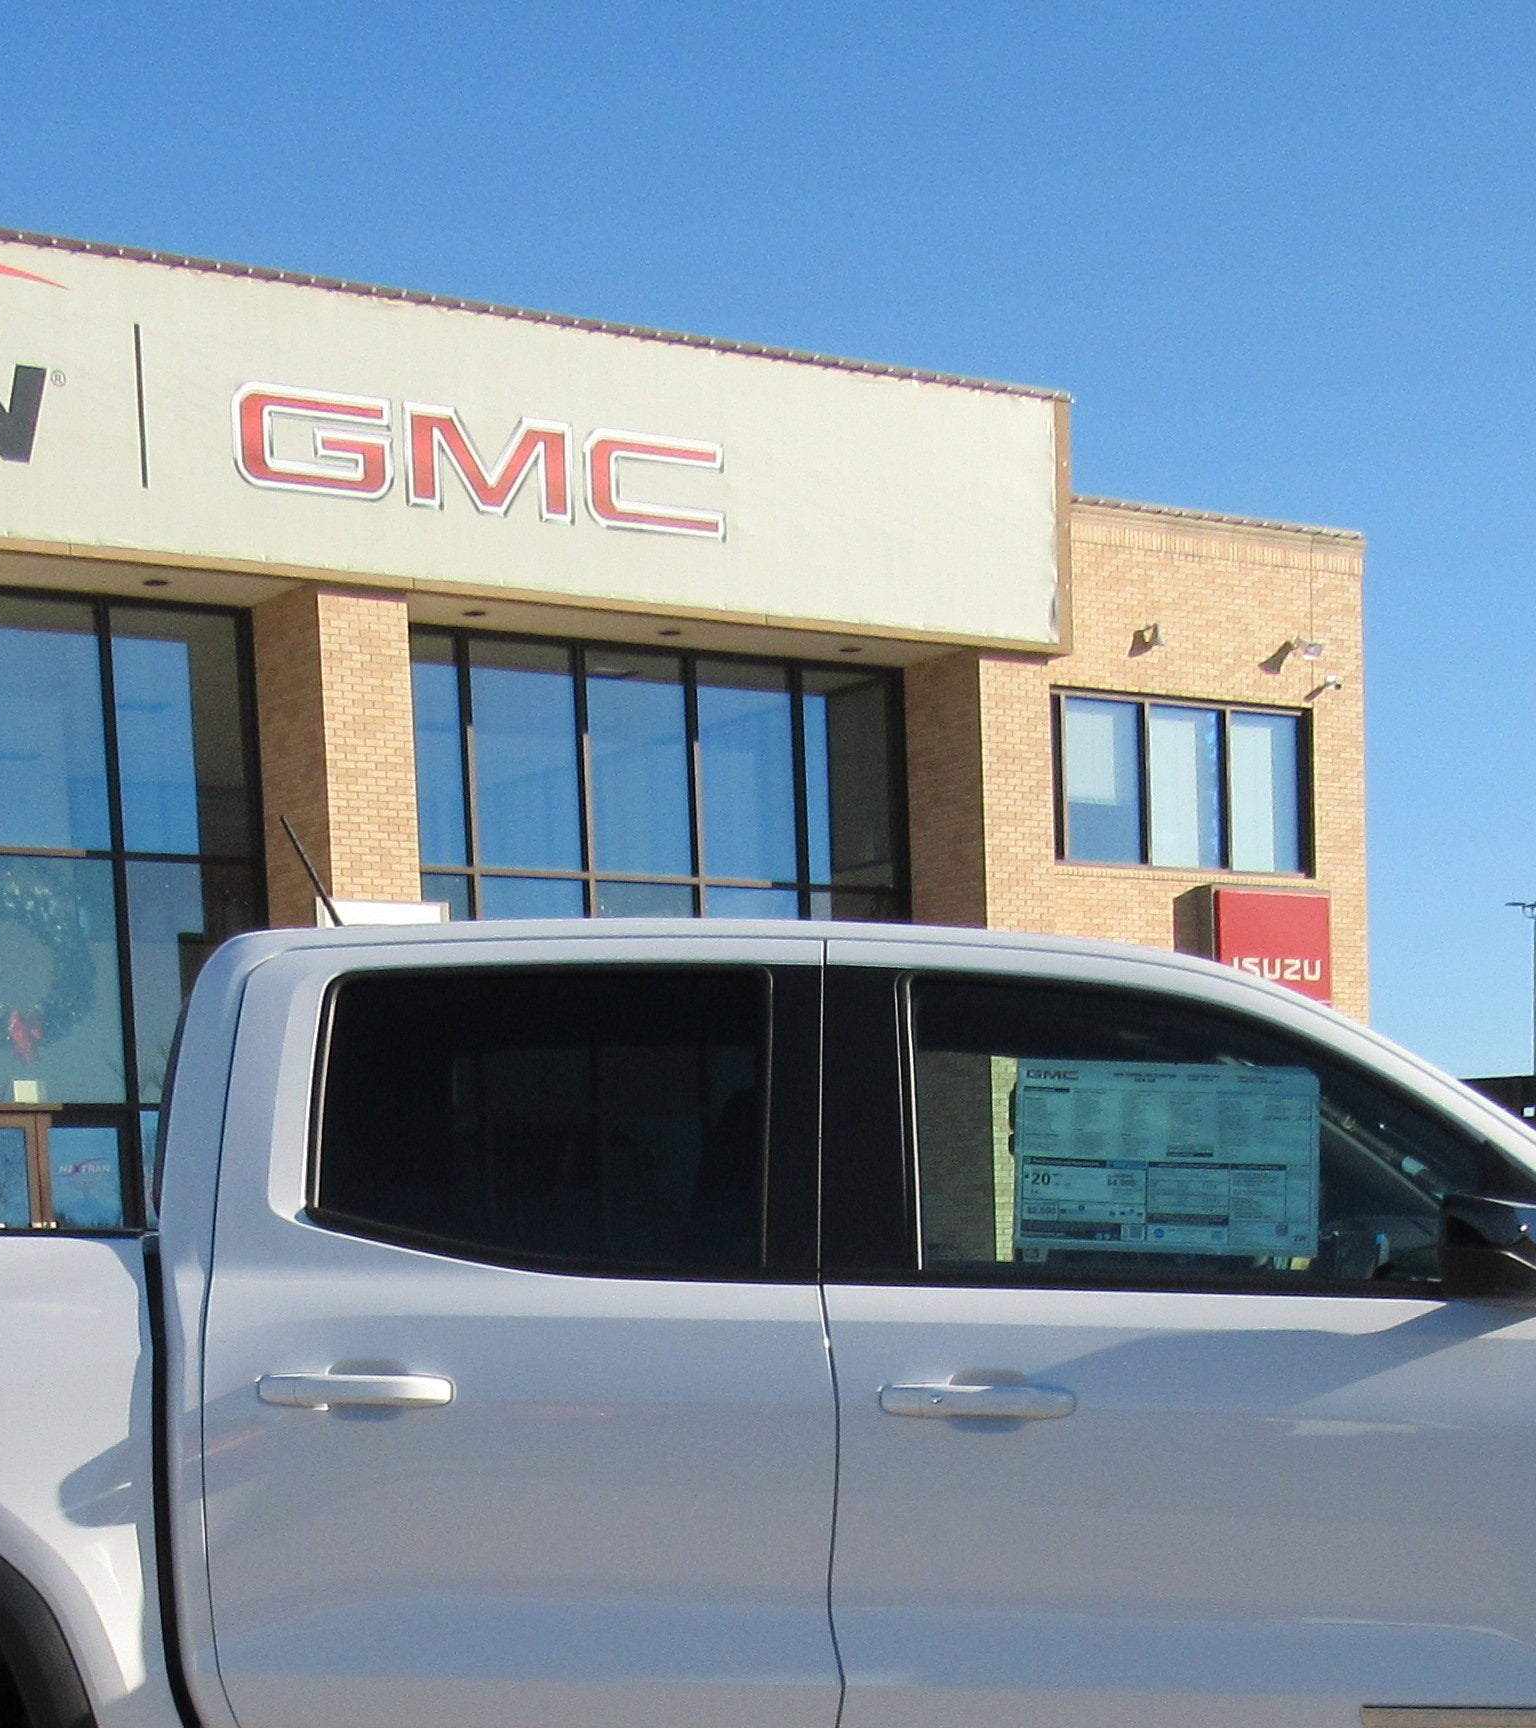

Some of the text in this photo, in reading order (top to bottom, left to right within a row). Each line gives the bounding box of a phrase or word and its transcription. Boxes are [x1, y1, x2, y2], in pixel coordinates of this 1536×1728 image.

[231, 380, 727, 541] GMC
[1026, 1069, 1079, 1081] GMC
[1030, 1172, 1051, 1187] 20
